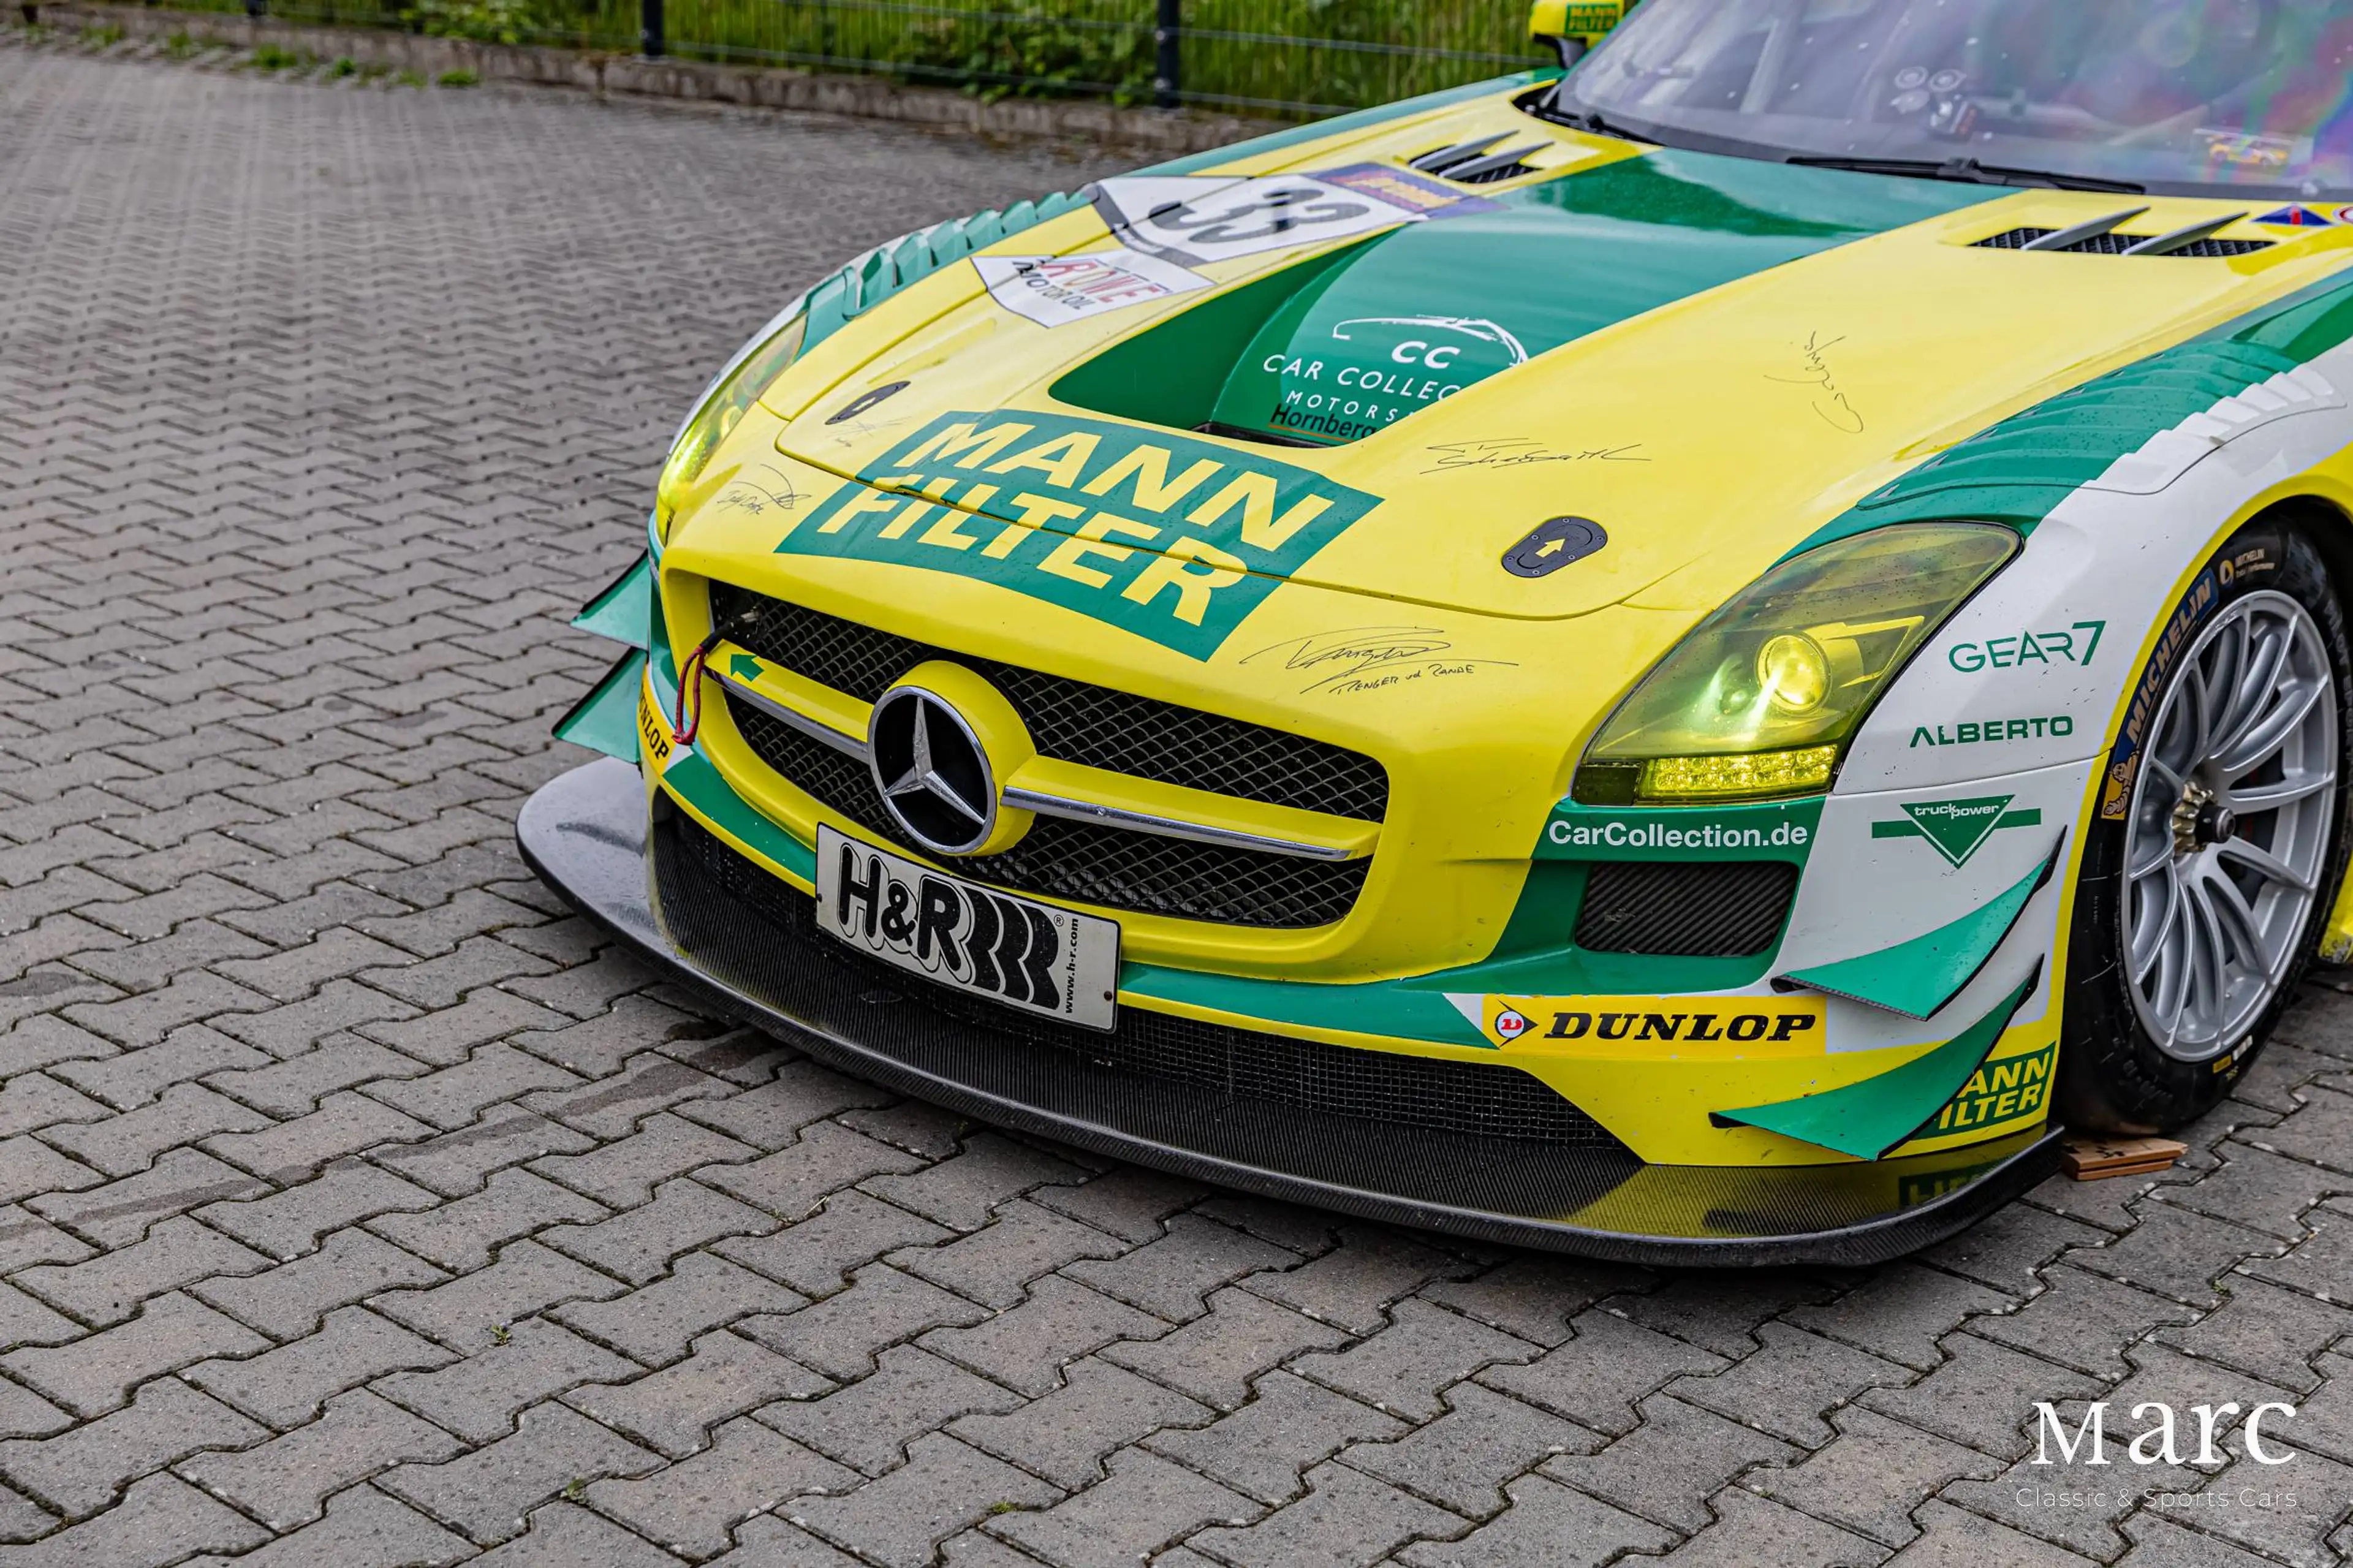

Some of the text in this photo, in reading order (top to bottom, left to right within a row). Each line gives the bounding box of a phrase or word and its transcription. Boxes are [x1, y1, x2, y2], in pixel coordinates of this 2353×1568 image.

[1263, 354, 1324, 380] CAR
[1392, 341, 1461, 369] CC
[893, 422, 1335, 552] MANN
[817, 473, 1248, 627] FILTER
[1949, 620, 2107, 673] GEAR7
[2126, 577, 2211, 745] MICHELIN
[1909, 715, 2074, 748] ALBERTO
[1548, 820, 1808, 848] CarCollection.de
[1065, 917, 1080, 1015] www.h-r.com
[1543, 1012, 1816, 1042] DUNLOP
[1956, 1051, 2050, 1099] ANN
[1938, 1083, 2042, 1130] ILTER
